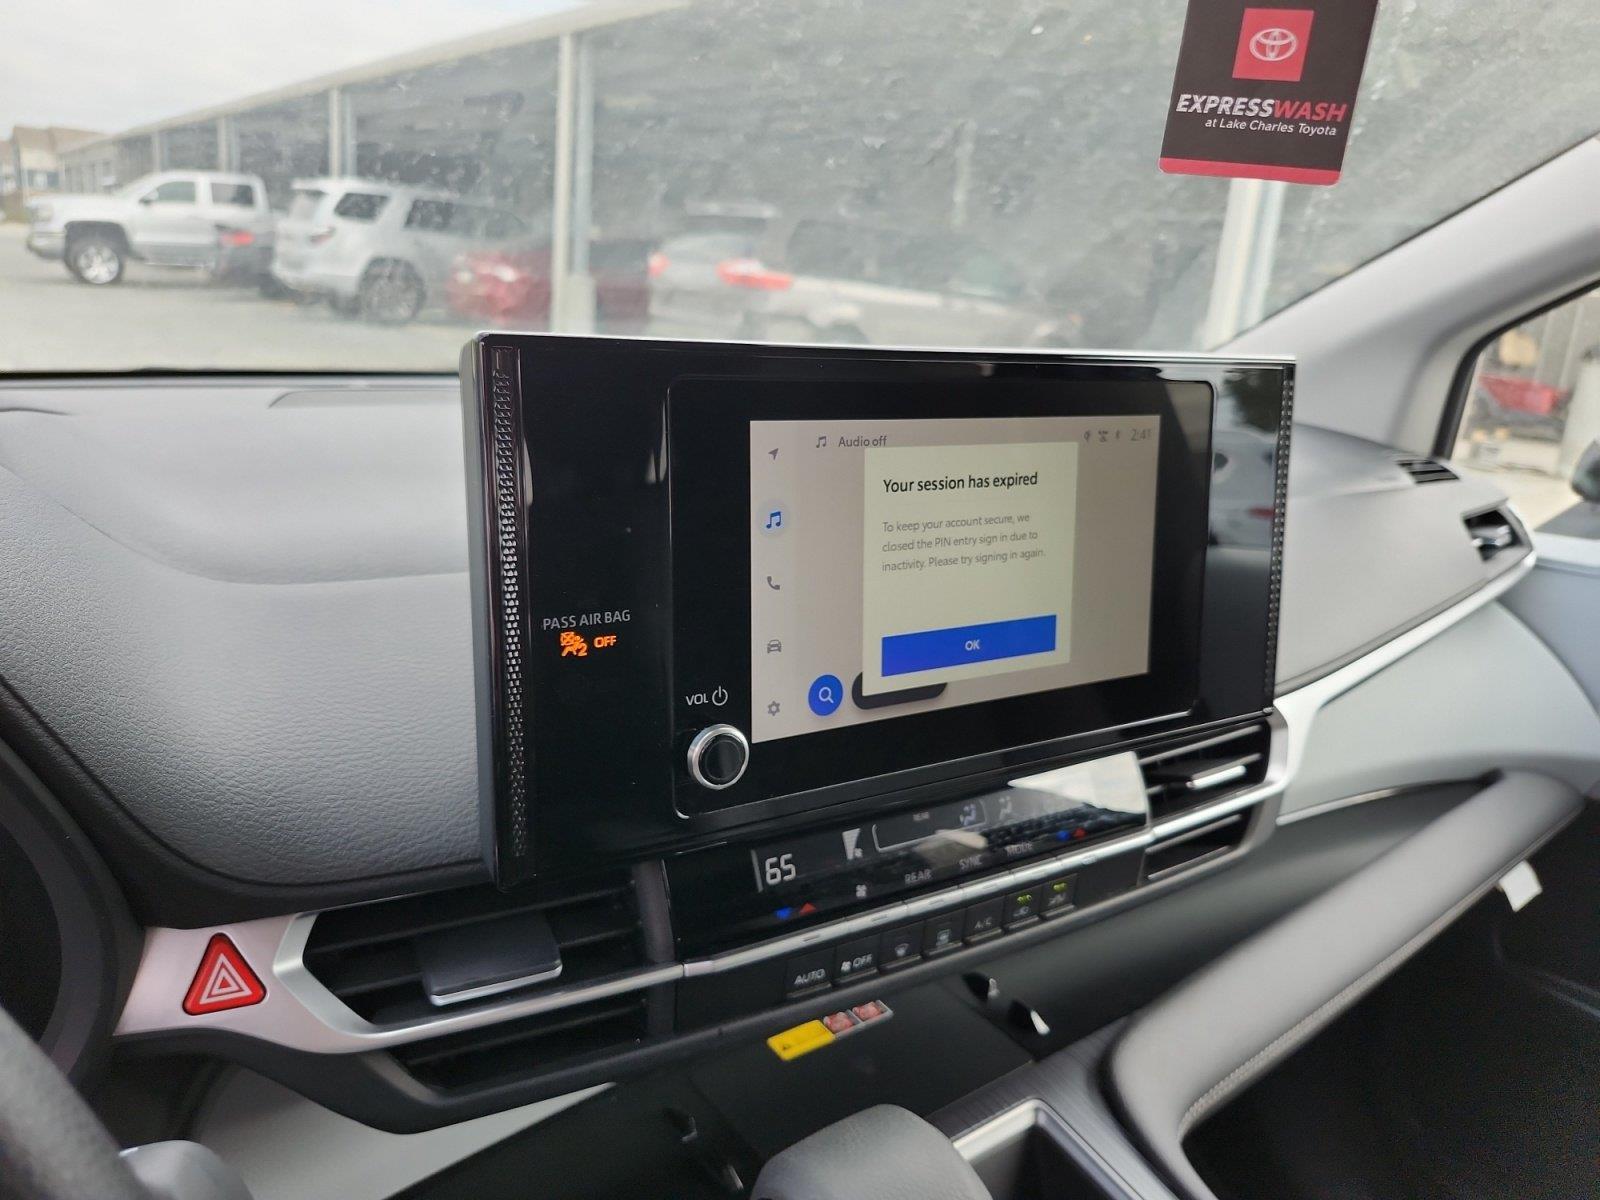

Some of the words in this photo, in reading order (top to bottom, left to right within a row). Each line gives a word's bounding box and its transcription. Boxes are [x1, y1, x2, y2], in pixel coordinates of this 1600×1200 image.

[1205, 118, 1217, 128] at
[1219, 117, 1247, 130] Lake
[1249, 119, 1294, 133] Charles
[1298, 122, 1337, 137] Toyota
[838, 435, 871, 448] Audio
[872, 435, 888, 448] off
[883, 479, 914, 493] Your
[917, 476, 965, 491] session
[968, 475, 990, 489] has
[993, 472, 1039, 490] expired
[882, 521, 894, 533] To
[896, 519, 920, 533] keep
[922, 518, 944, 533] your
[945, 516, 983, 529] account
[984, 514, 1015, 526] secure,
[1017, 513, 1030, 522] we
[882, 540, 914, 553] closed
[916, 537, 933, 550] the
[935, 536, 951, 548] PIN
[953, 534, 977, 548] entry
[978, 531, 998, 545] sign
[1000, 531, 1007, 542] in
[1010, 529, 1027, 542] due
[1029, 529, 1038, 540] to
[882, 557, 926, 573] inactivity.
[928, 555, 959, 568] Please
[961, 553, 974, 566] try
[975, 550, 1008, 566] signing
[1010, 549, 1018, 560] in
[1019, 546, 1047, 560] again.
[543, 615, 577, 631] PASS
[579, 612, 602, 627] AIR
[604, 609, 631, 623] BAG
[594, 634, 618, 649] OFF
[965, 639, 981, 652] OK
[686, 693, 709, 706] VOL
[765, 853, 796, 885] 65
[959, 855, 982, 870] SYNC
[904, 868, 932, 885] REAR
[852, 953, 873, 969] OFF
[793, 968, 826, 985] AUTO
